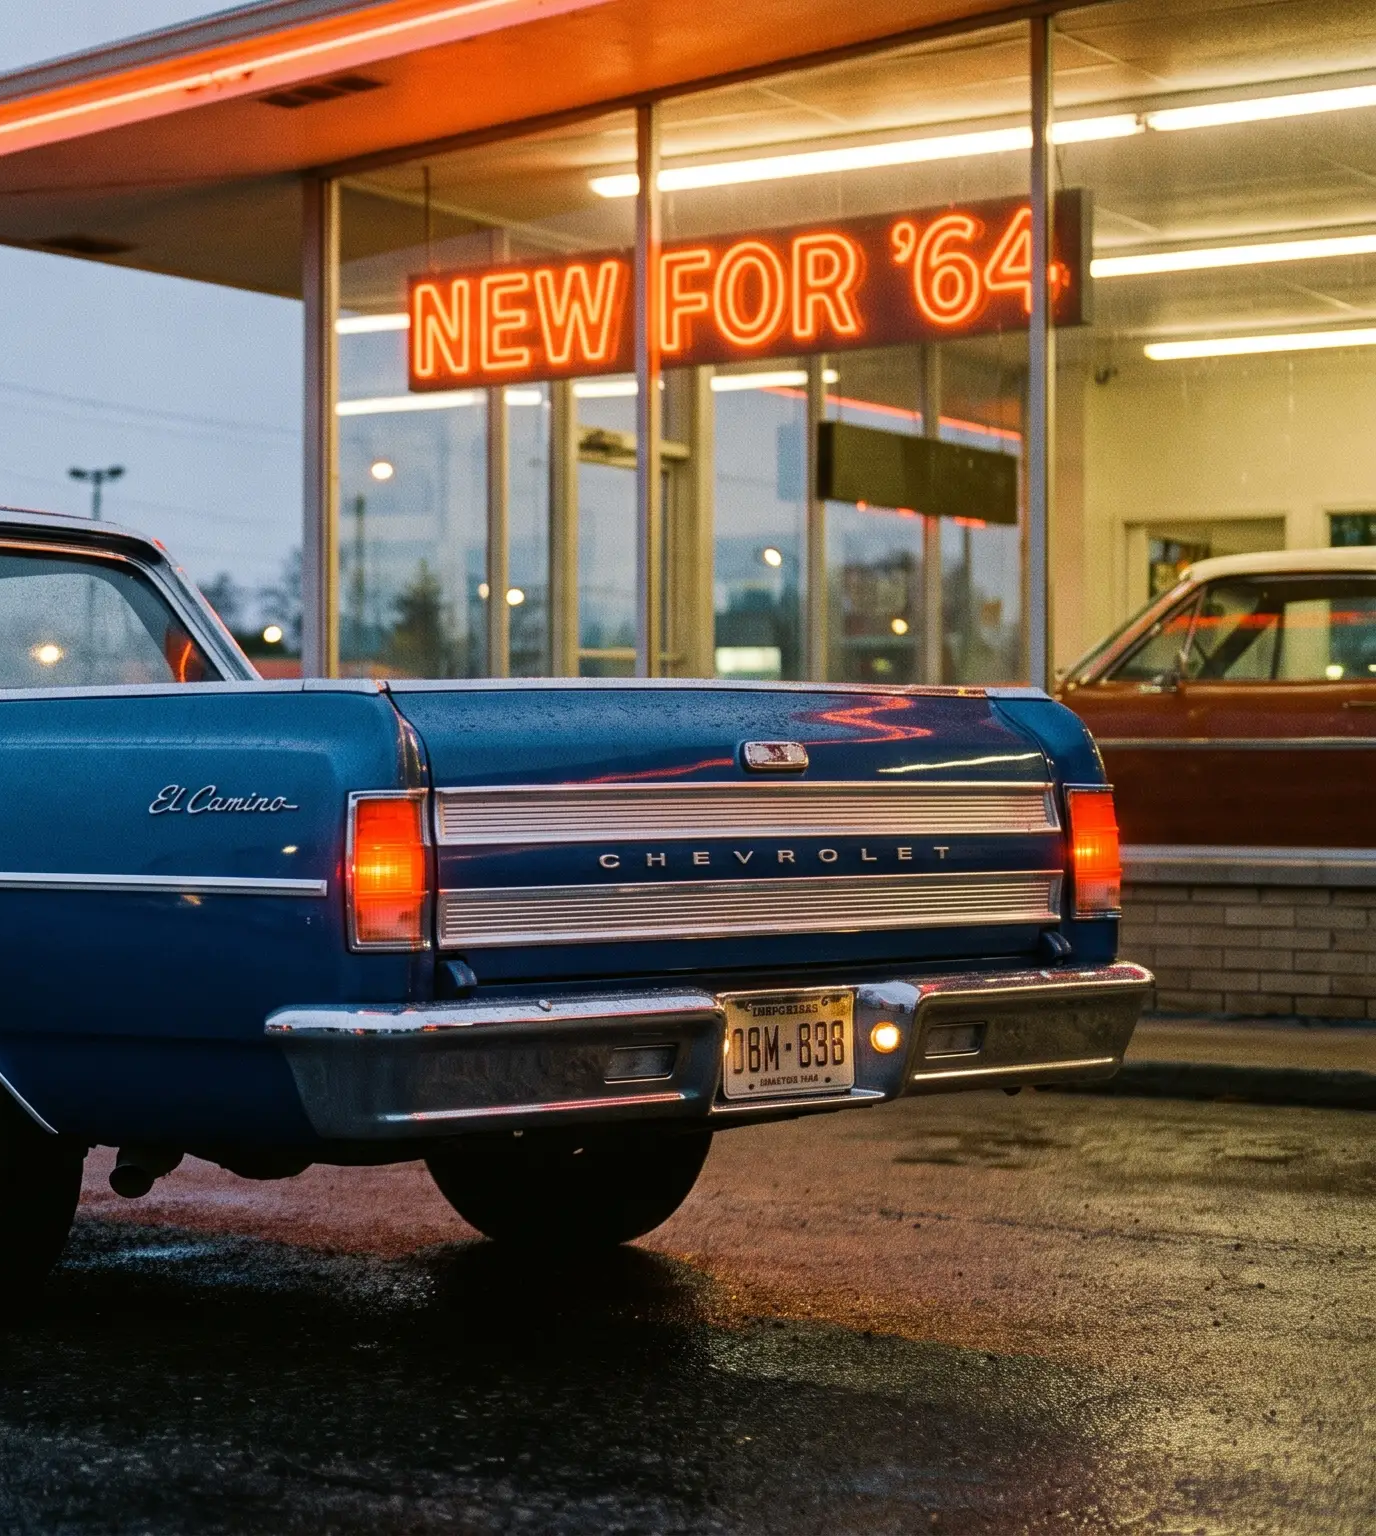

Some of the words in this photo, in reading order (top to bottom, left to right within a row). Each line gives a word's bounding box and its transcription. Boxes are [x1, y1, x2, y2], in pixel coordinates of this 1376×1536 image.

[413, 261, 619, 378] NEW
[657, 231, 860, 352] FOR
[148, 784, 187, 814] El
[186, 784, 298, 814] Camino
[599, 846, 950, 869] CHEVROLET
